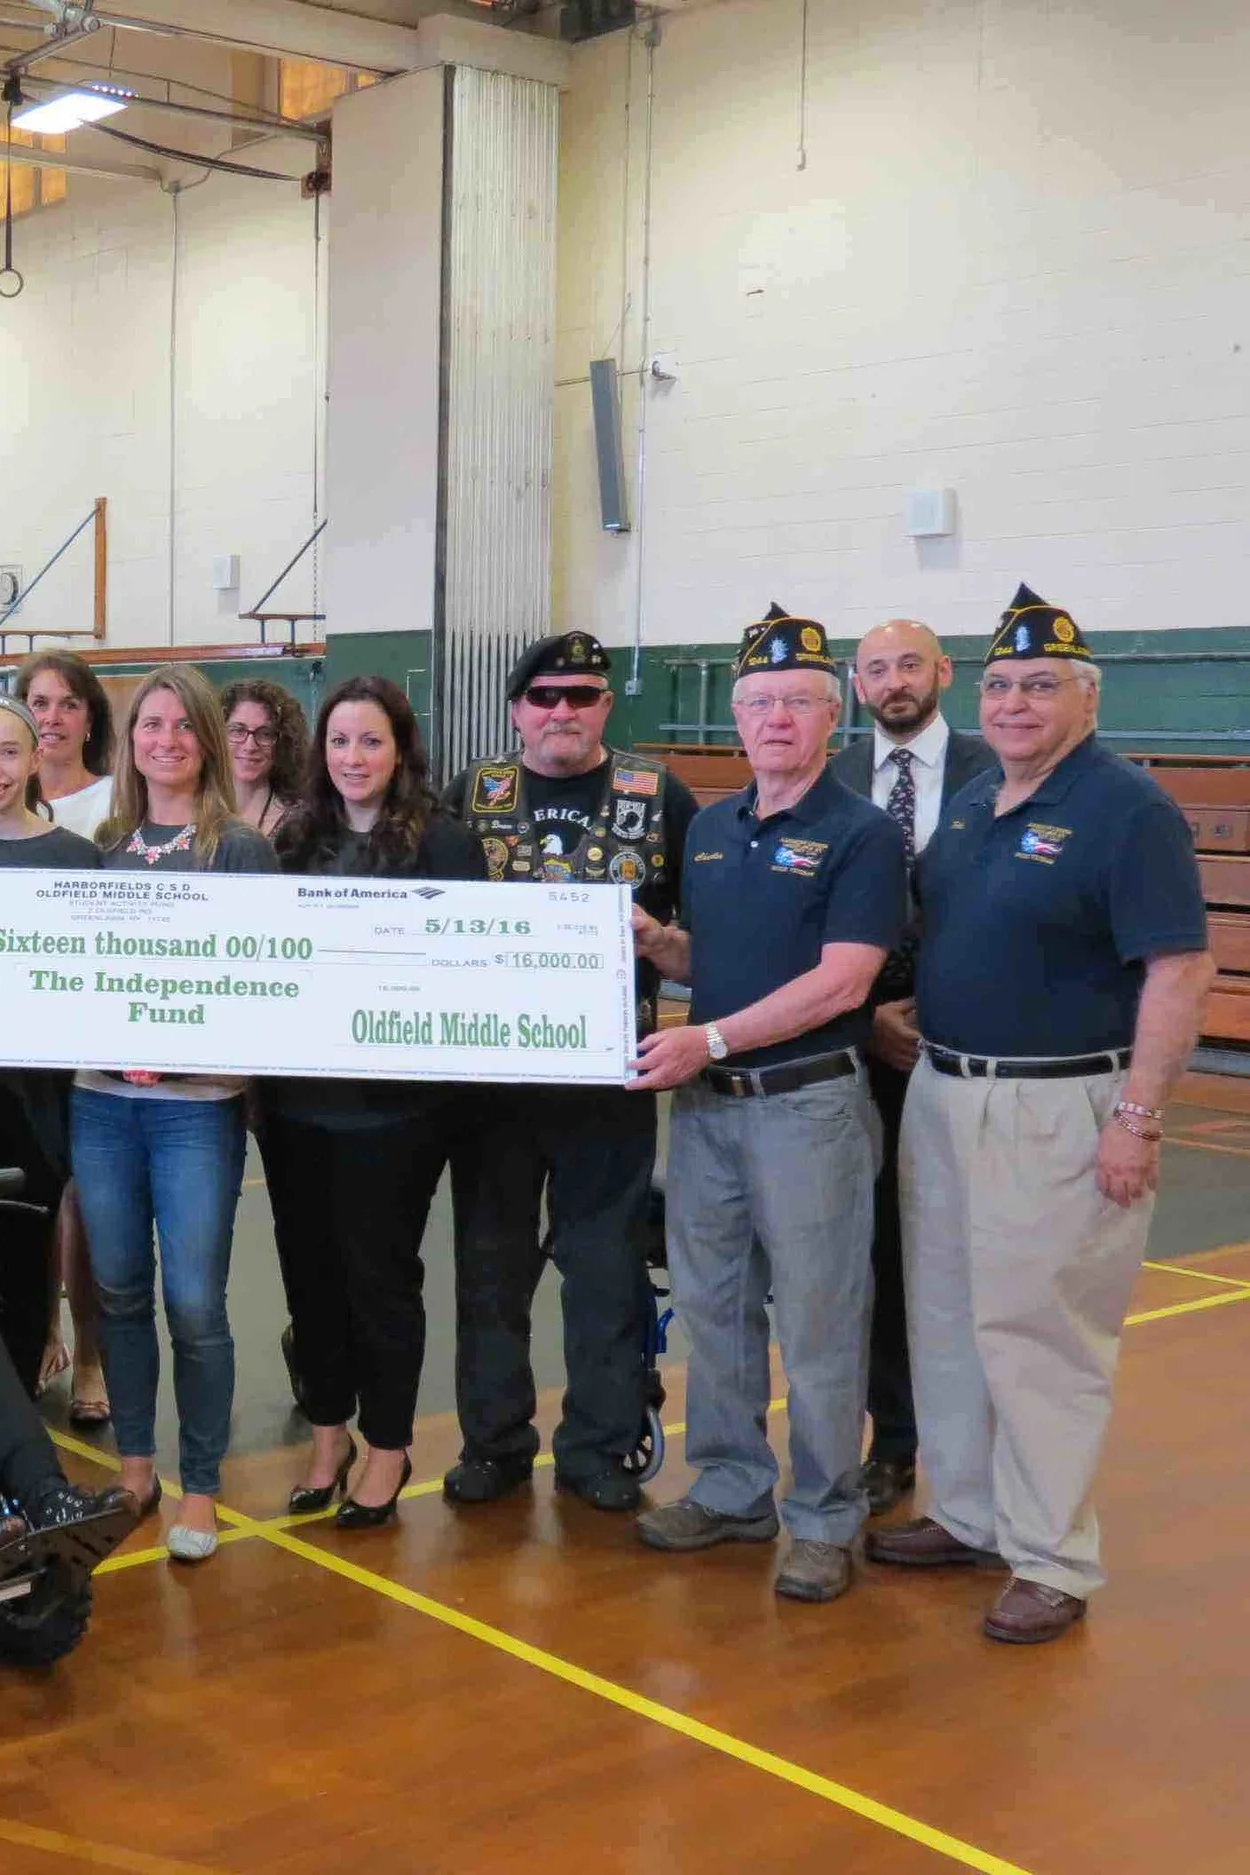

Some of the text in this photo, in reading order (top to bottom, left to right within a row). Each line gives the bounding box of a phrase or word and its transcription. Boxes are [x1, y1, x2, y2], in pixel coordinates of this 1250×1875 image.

[36, 889, 209, 901] OLDFIELD MIDDLE SCHOOL
[54, 881, 191, 892] HARBORFIELDS C S D
[298, 887, 408, 899] Bank of America
[374, 918, 532, 936] DATE 5/13/16
[95, 931, 217, 957] thousand
[226, 934, 313, 961] 00/100
[431, 958, 488, 968] DOLLARS
[512, 952, 599, 971] 16,000.00
[29, 970, 300, 1001] The Independence
[128, 1001, 205, 1025] Fund
[351, 1008, 434, 1045] Oldfield
[439, 1012, 511, 1048] Middle
[517, 1013, 588, 1049] School
